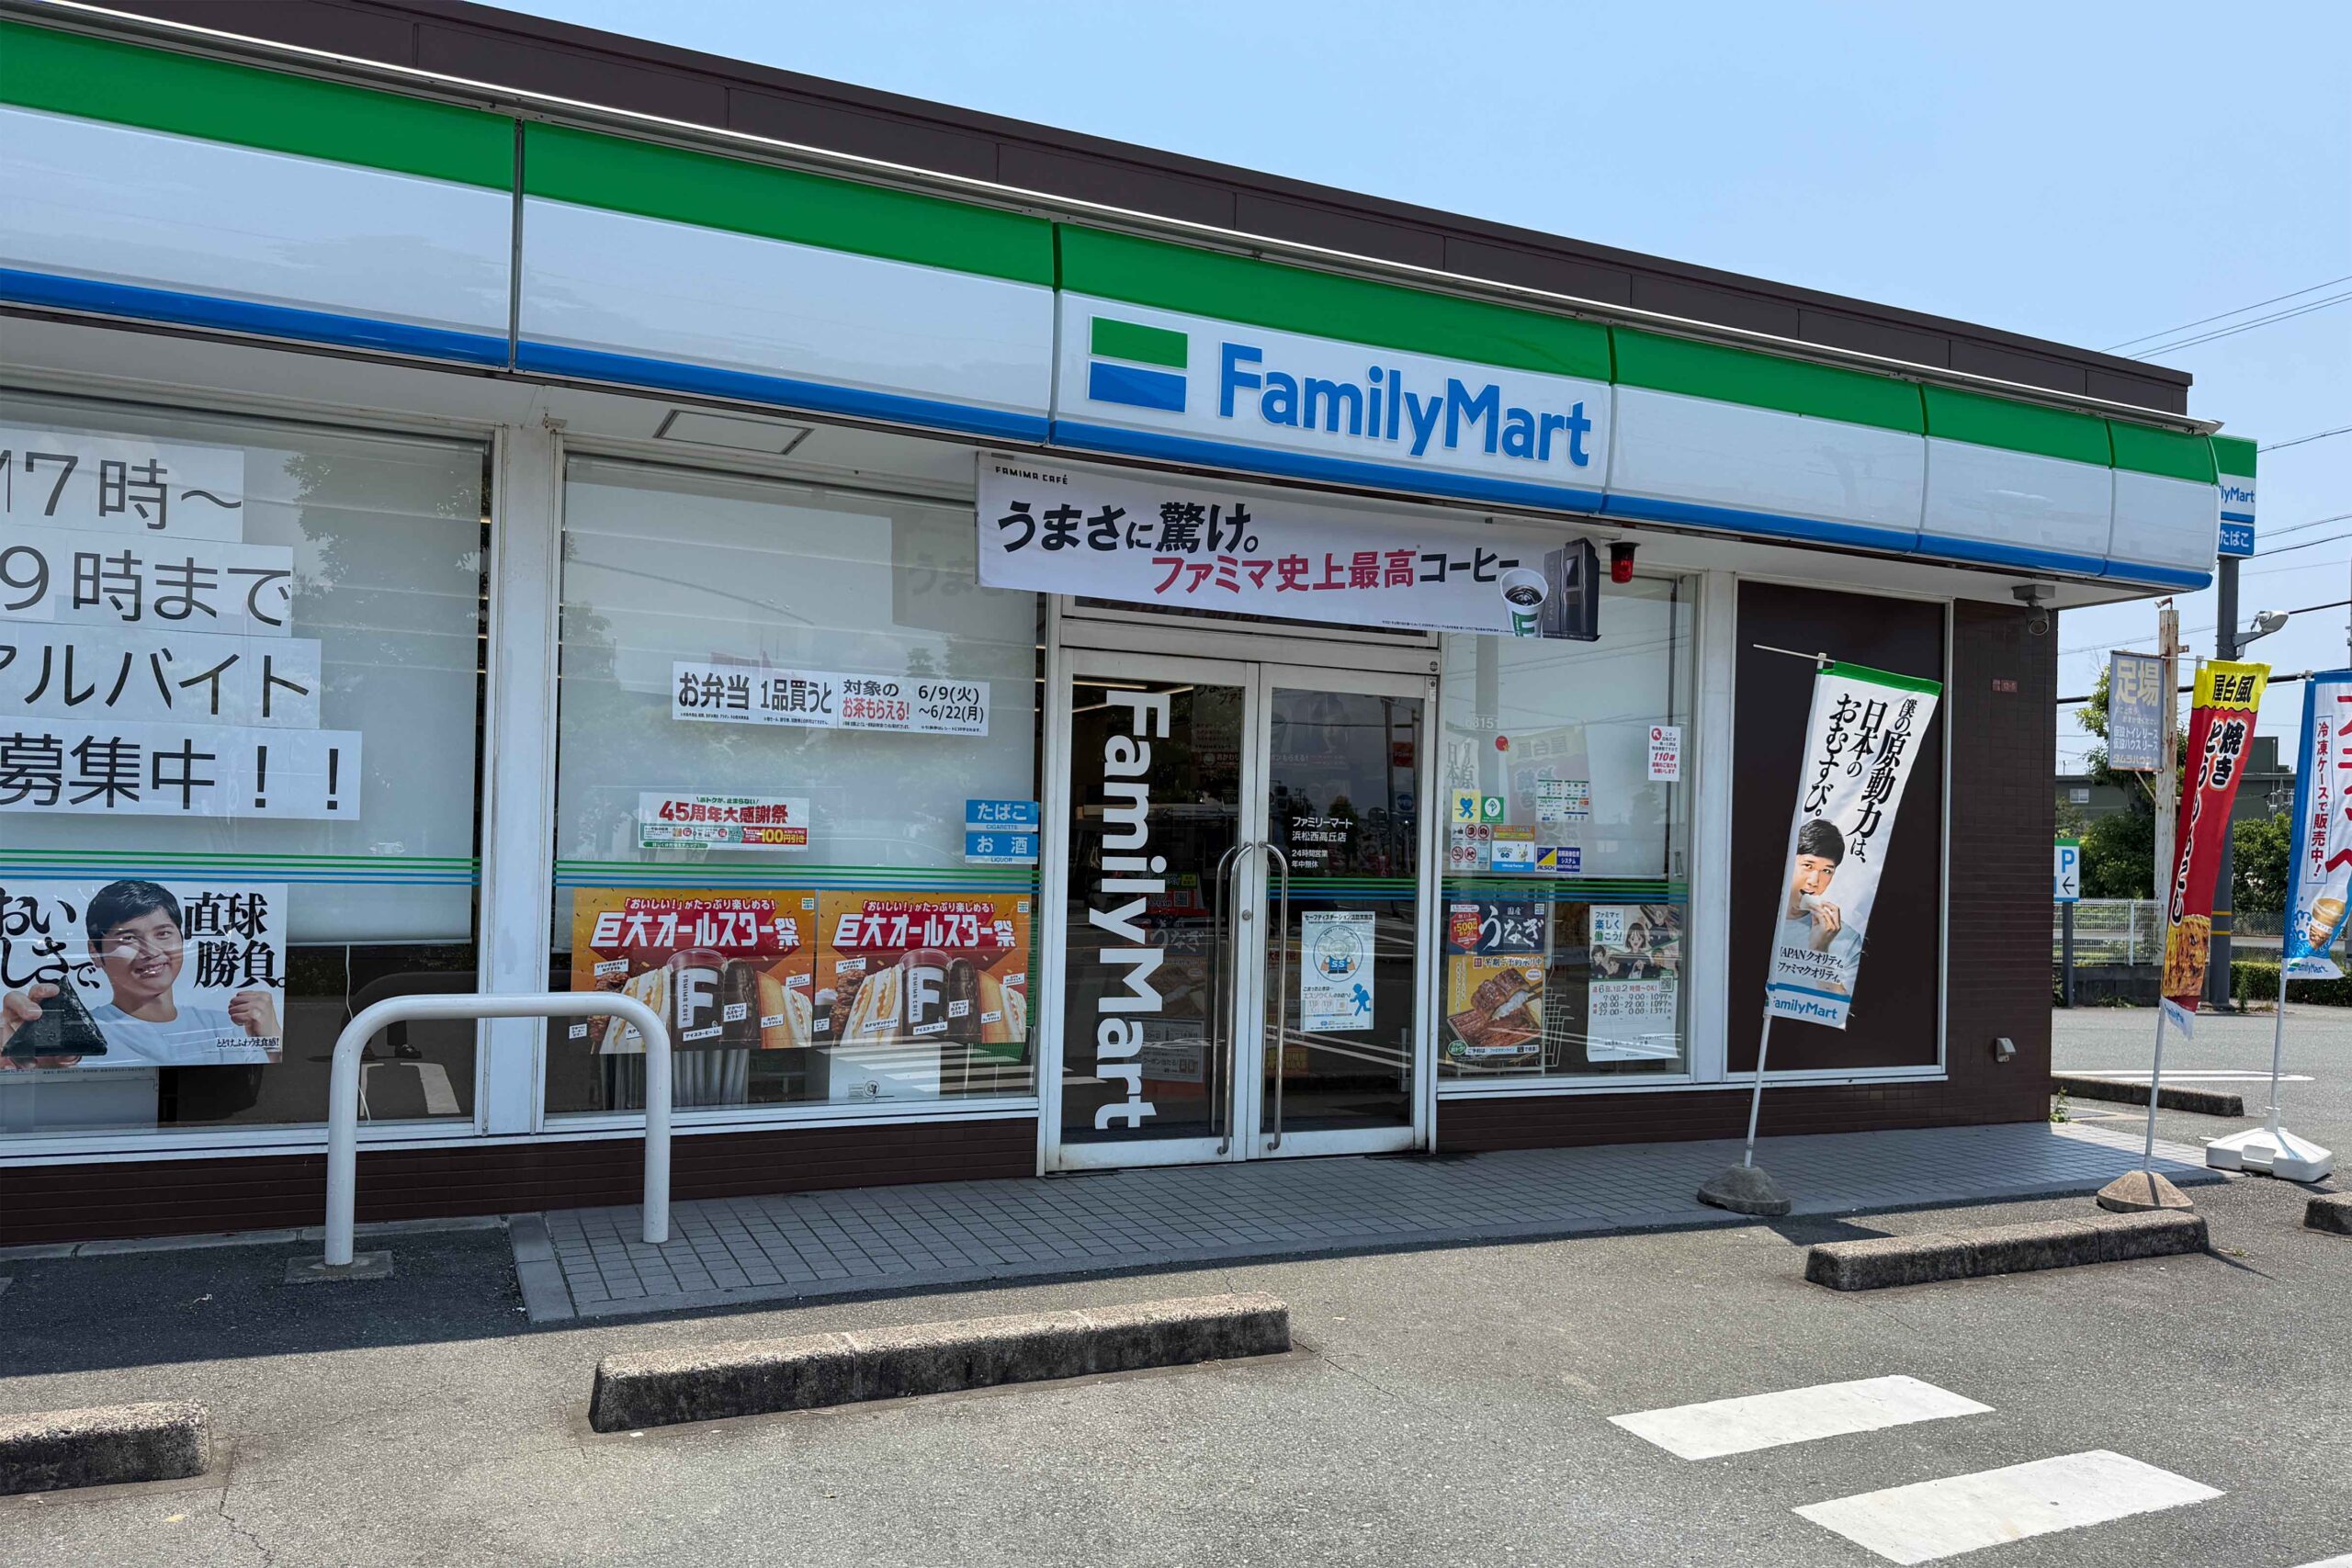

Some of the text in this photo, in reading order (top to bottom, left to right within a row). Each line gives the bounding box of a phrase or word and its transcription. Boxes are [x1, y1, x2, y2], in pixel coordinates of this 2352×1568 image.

[1218, 340, 1592, 467] FamilyMart
[995, 466, 1068, 485] FAMIMA CAFÉ
[998, 501, 1260, 554] うまさに驚け。
[2220, 529, 2250, 547] たばこ
[1151, 547, 1519, 595] ファミマ史上最高コーヒー
[678, 671, 832, 714] お弁当 1品買うと
[842, 679, 899, 697] 対象の
[918, 684, 979, 705] 6/9(火)
[2115, 659, 2160, 706] 足場
[2211, 673, 2256, 704] 屋台風
[842, 697, 910, 721] お茶もらえる!
[1846, 699, 1889, 778] 日本の
[1804, 693, 1862, 817] おむすび。
[2211, 721, 2245, 786] 焼き
[0, 732, 339, 810] 募集中！！
[659, 801, 789, 824] 45周年大感謝祭
[977, 802, 1027, 821] たばこ
[2311, 721, 2329, 877] 冷凍ケースで販売中!
[1292, 817, 1353, 829] ファミリーマート
[1292, 830, 1347, 842] 浜松西高丘店
[977, 835, 1028, 854] お酒
[1291, 849, 1329, 858] 24時間営業
[2061, 849, 2075, 874] P
[184, 891, 269, 940] 直球
[624, 897, 776, 910] 「おいしい!」がたっぷり楽しめる!
[862, 900, 996, 913] 「おいしい!」がたっぷり楽しめる!
[1089, 689, 1170, 1131] FamilyMart
[590, 910, 800, 947] 巨大オールスター祭
[831, 913, 1016, 947] 巨大オールスター祭
[1478, 905, 1544, 951] うなぎ
[1595, 919, 1620, 930] 楽しく
[1595, 931, 1623, 942] 働こう!
[194, 940, 286, 988] 勝負。
[1773, 997, 1838, 1020] amilyMart
